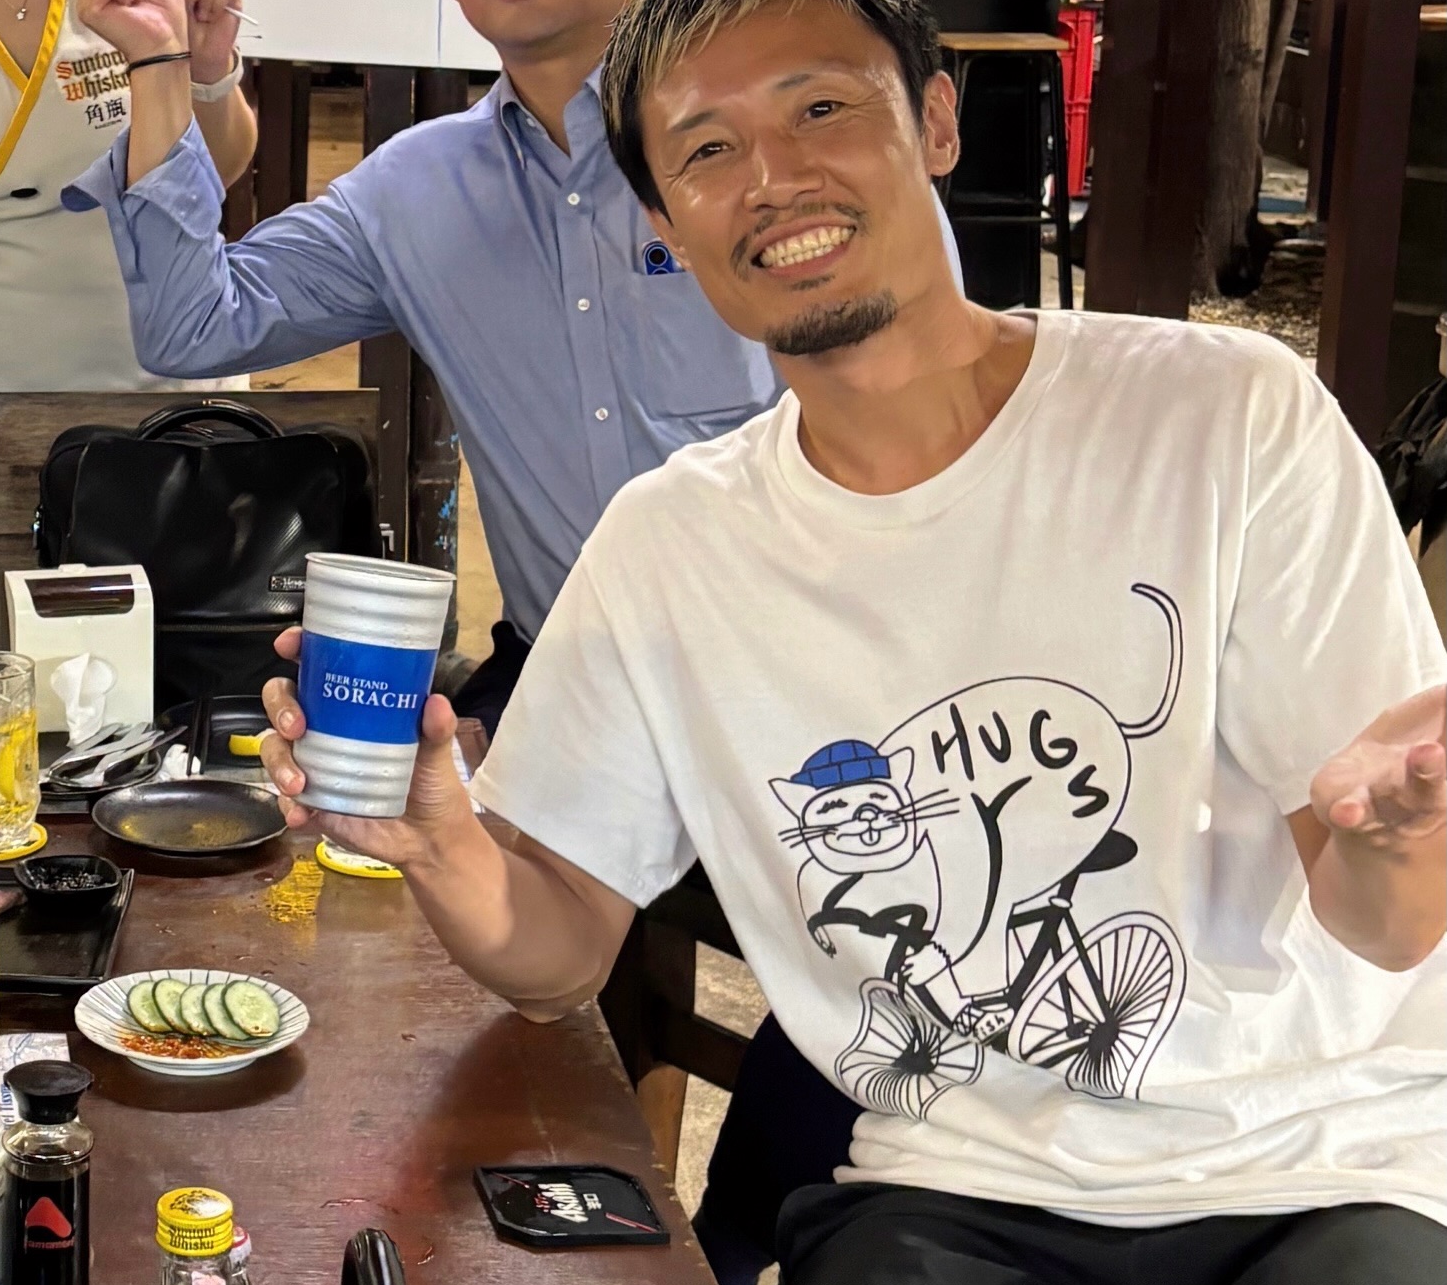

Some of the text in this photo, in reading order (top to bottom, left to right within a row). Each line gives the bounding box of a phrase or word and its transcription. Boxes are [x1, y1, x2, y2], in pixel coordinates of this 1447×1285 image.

[325, 672, 389, 691] BEER STAND
[322, 682, 418, 710] SORACHI
